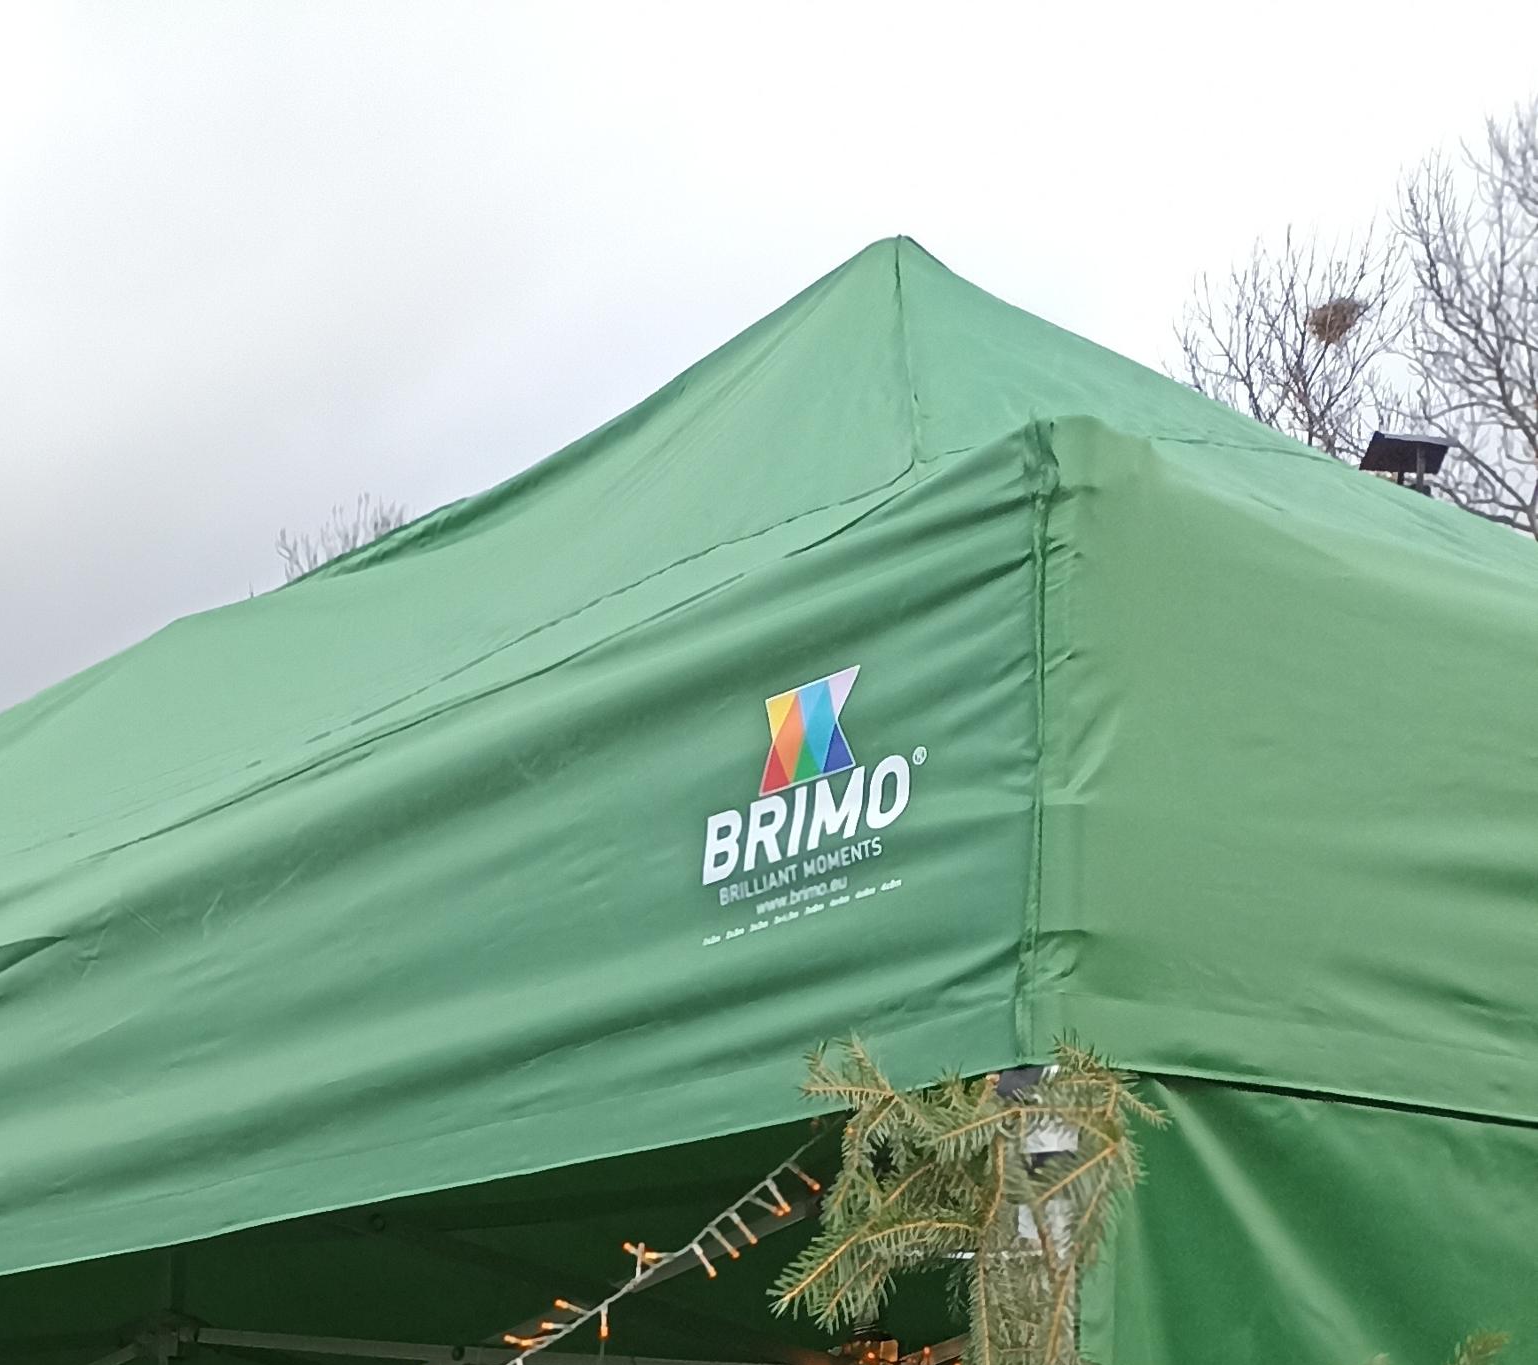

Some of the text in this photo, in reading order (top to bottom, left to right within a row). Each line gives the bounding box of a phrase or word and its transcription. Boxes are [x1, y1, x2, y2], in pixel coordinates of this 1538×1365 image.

[702, 755, 910, 885] BRIMO
[718, 836, 883, 906] BRILLIANT MOMENTS
[755, 876, 848, 915] www.brimo.eu
